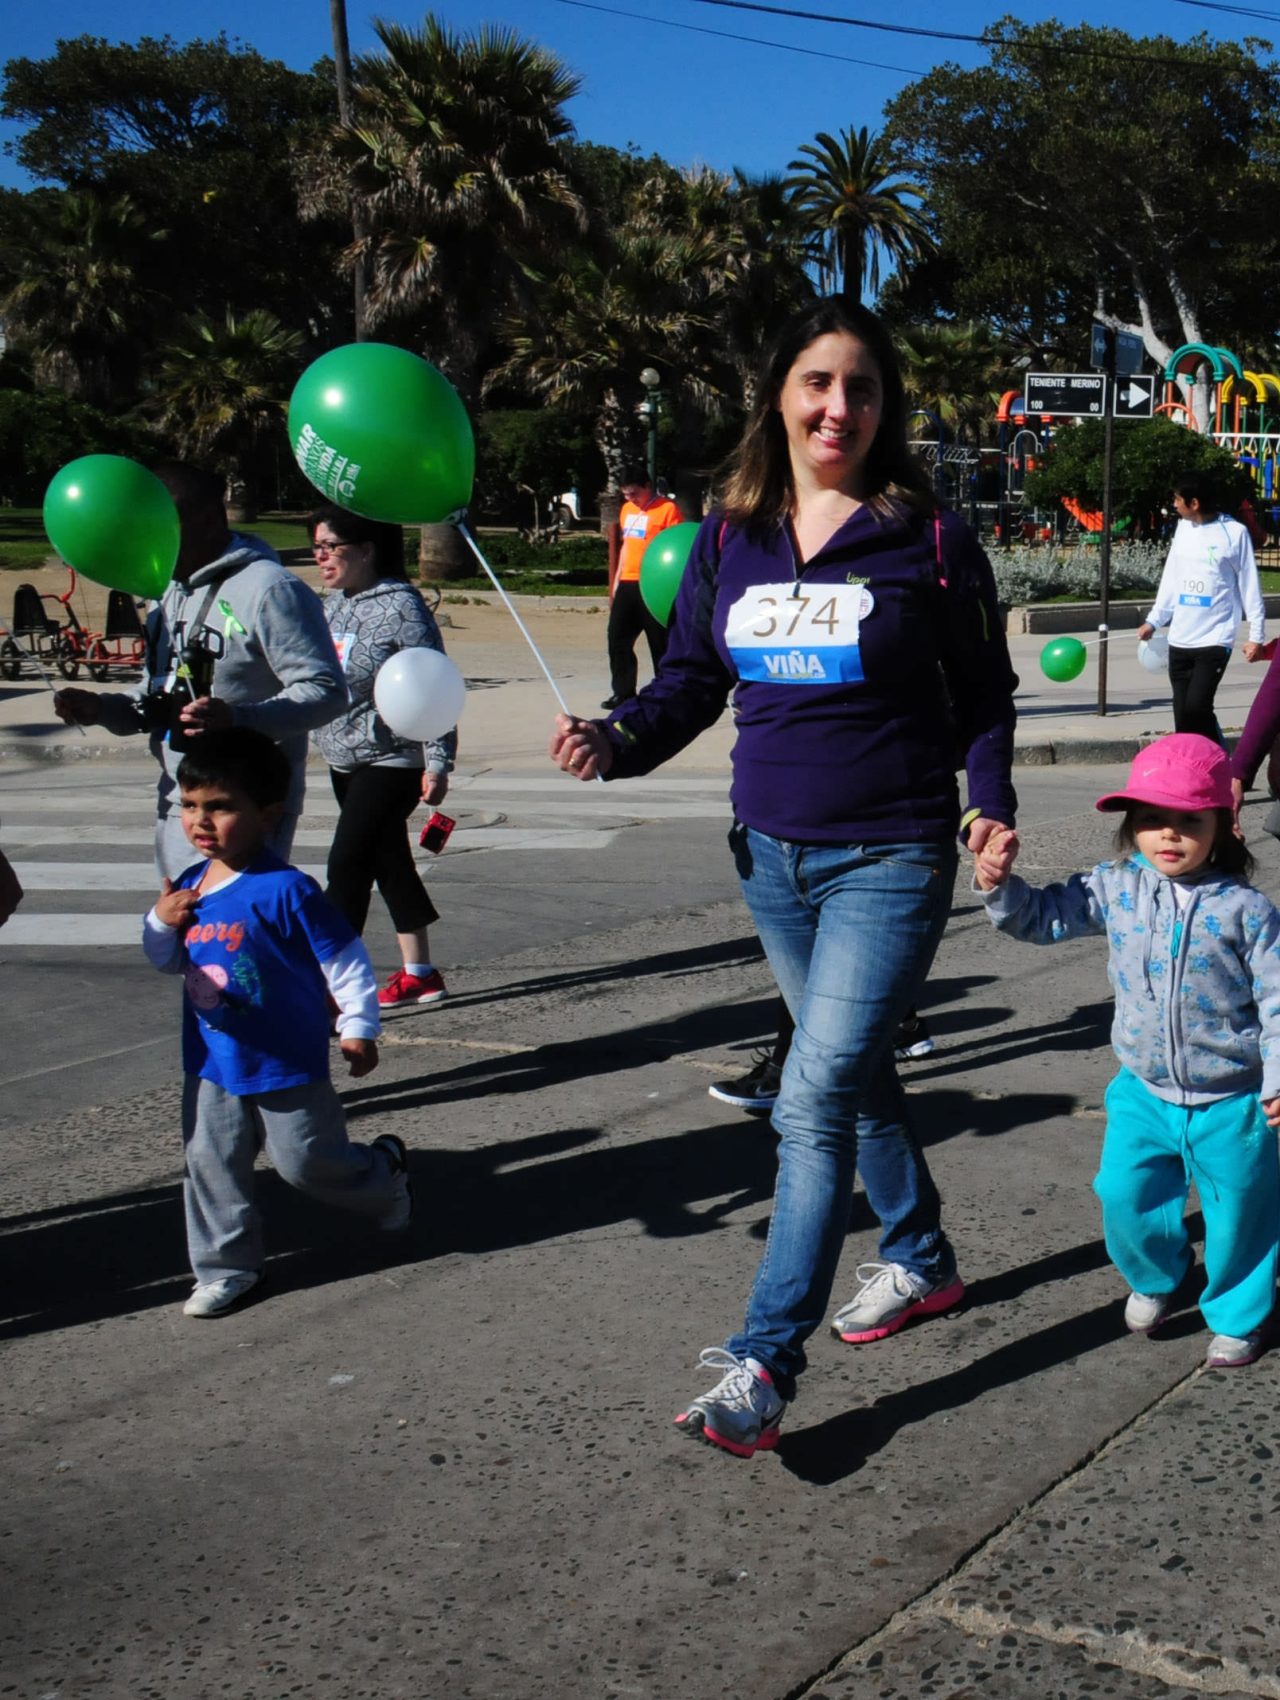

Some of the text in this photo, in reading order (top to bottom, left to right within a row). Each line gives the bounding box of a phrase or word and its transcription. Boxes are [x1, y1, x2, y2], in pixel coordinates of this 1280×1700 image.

[1030, 377, 1101, 389] TENIENTE MERINO
[1030, 400, 1100, 412] 100 00
[1183, 580, 1205, 593] 190
[752, 597, 840, 638] 374
[762, 650, 827, 674] VIÑA
